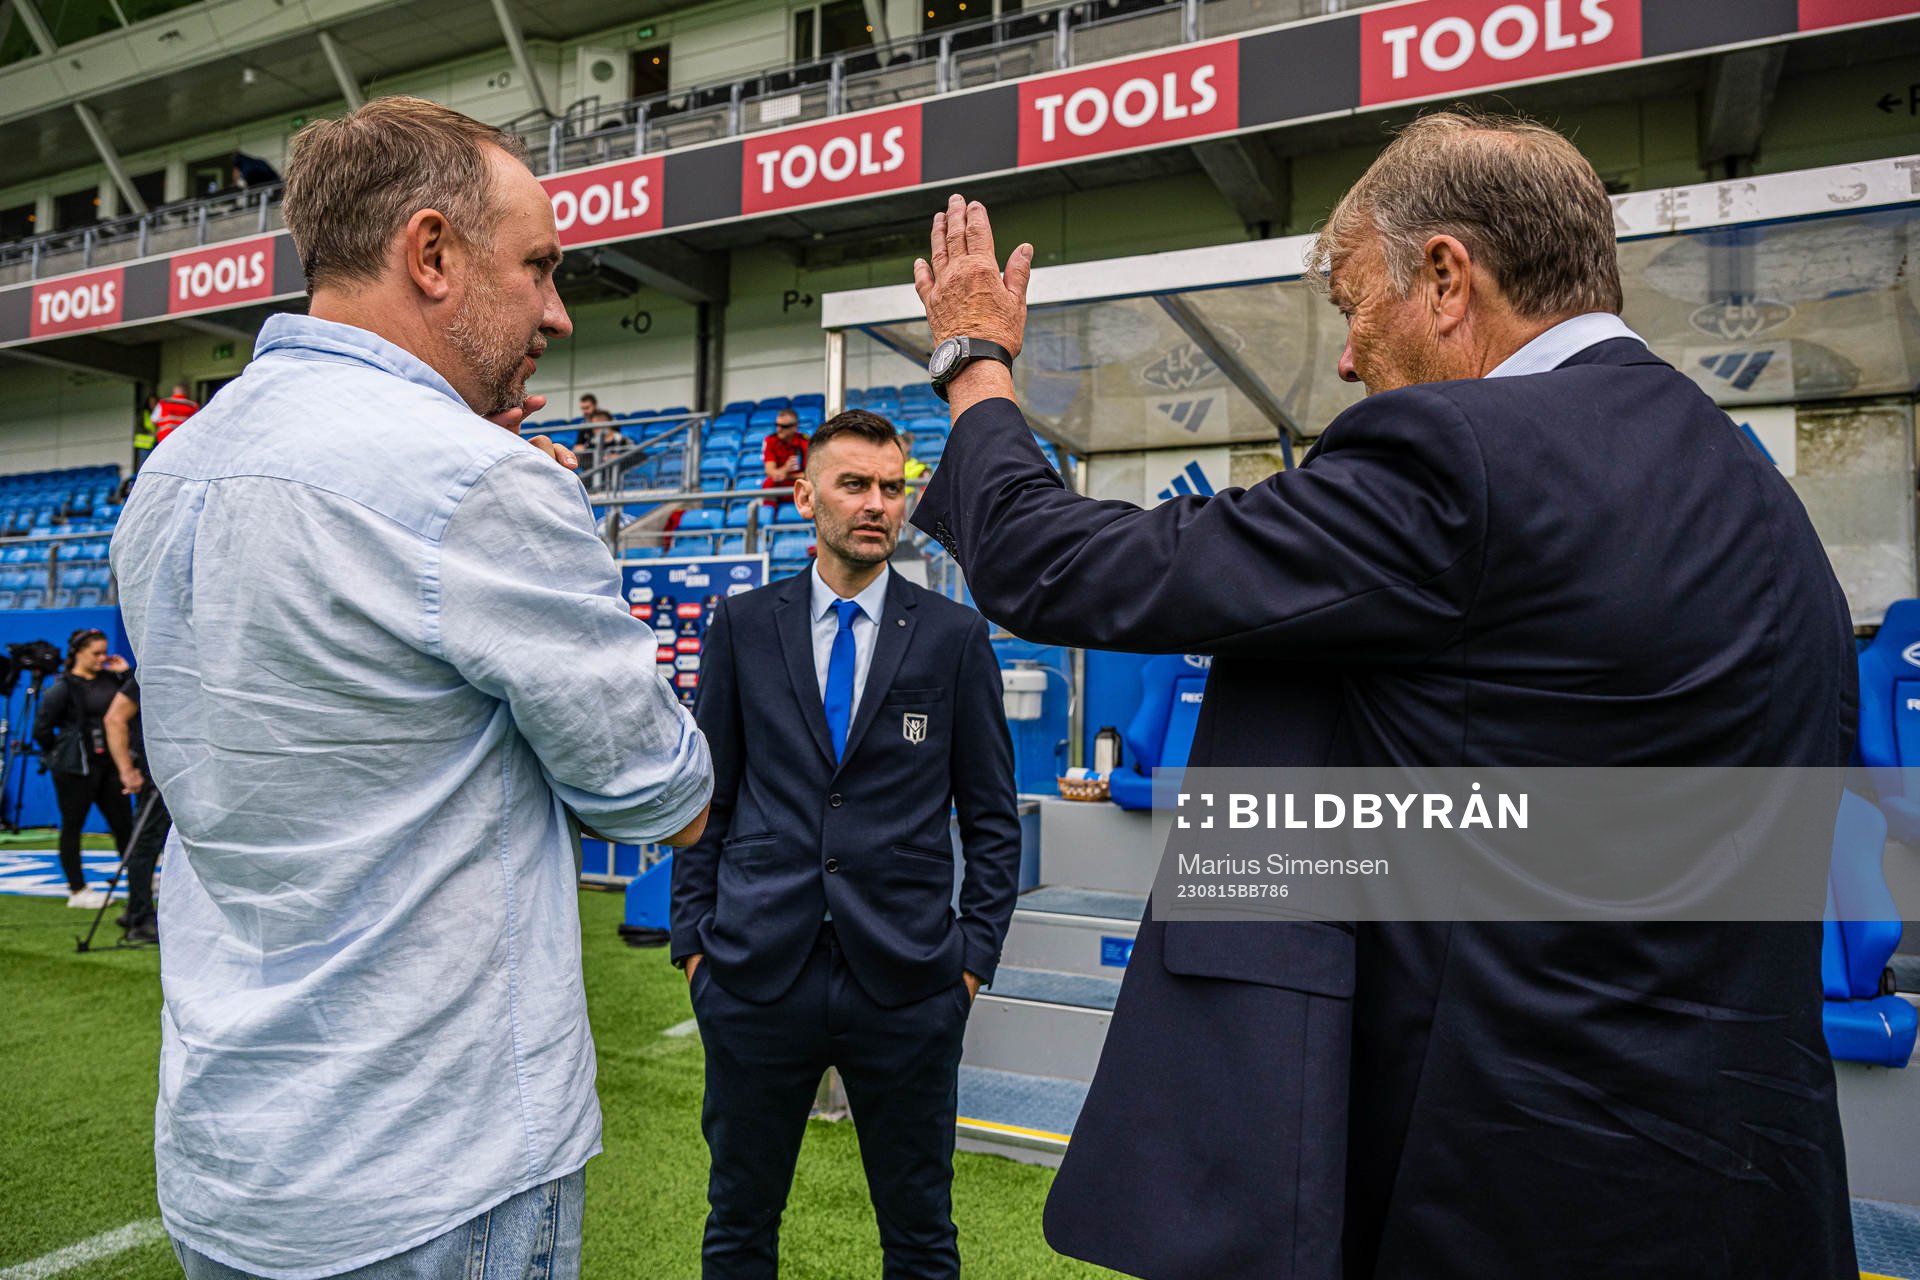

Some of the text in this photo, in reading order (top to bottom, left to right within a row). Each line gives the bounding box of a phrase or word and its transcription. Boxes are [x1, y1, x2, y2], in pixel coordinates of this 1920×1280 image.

[1382, 0, 1614, 79] TOOLS
[1035, 64, 1217, 142] TOOLS
[756, 126, 905, 194] TOOLS
[553, 175, 650, 232] OOLS
[39, 281, 116, 325] TOOLS
[176, 251, 265, 300] TOOLS
